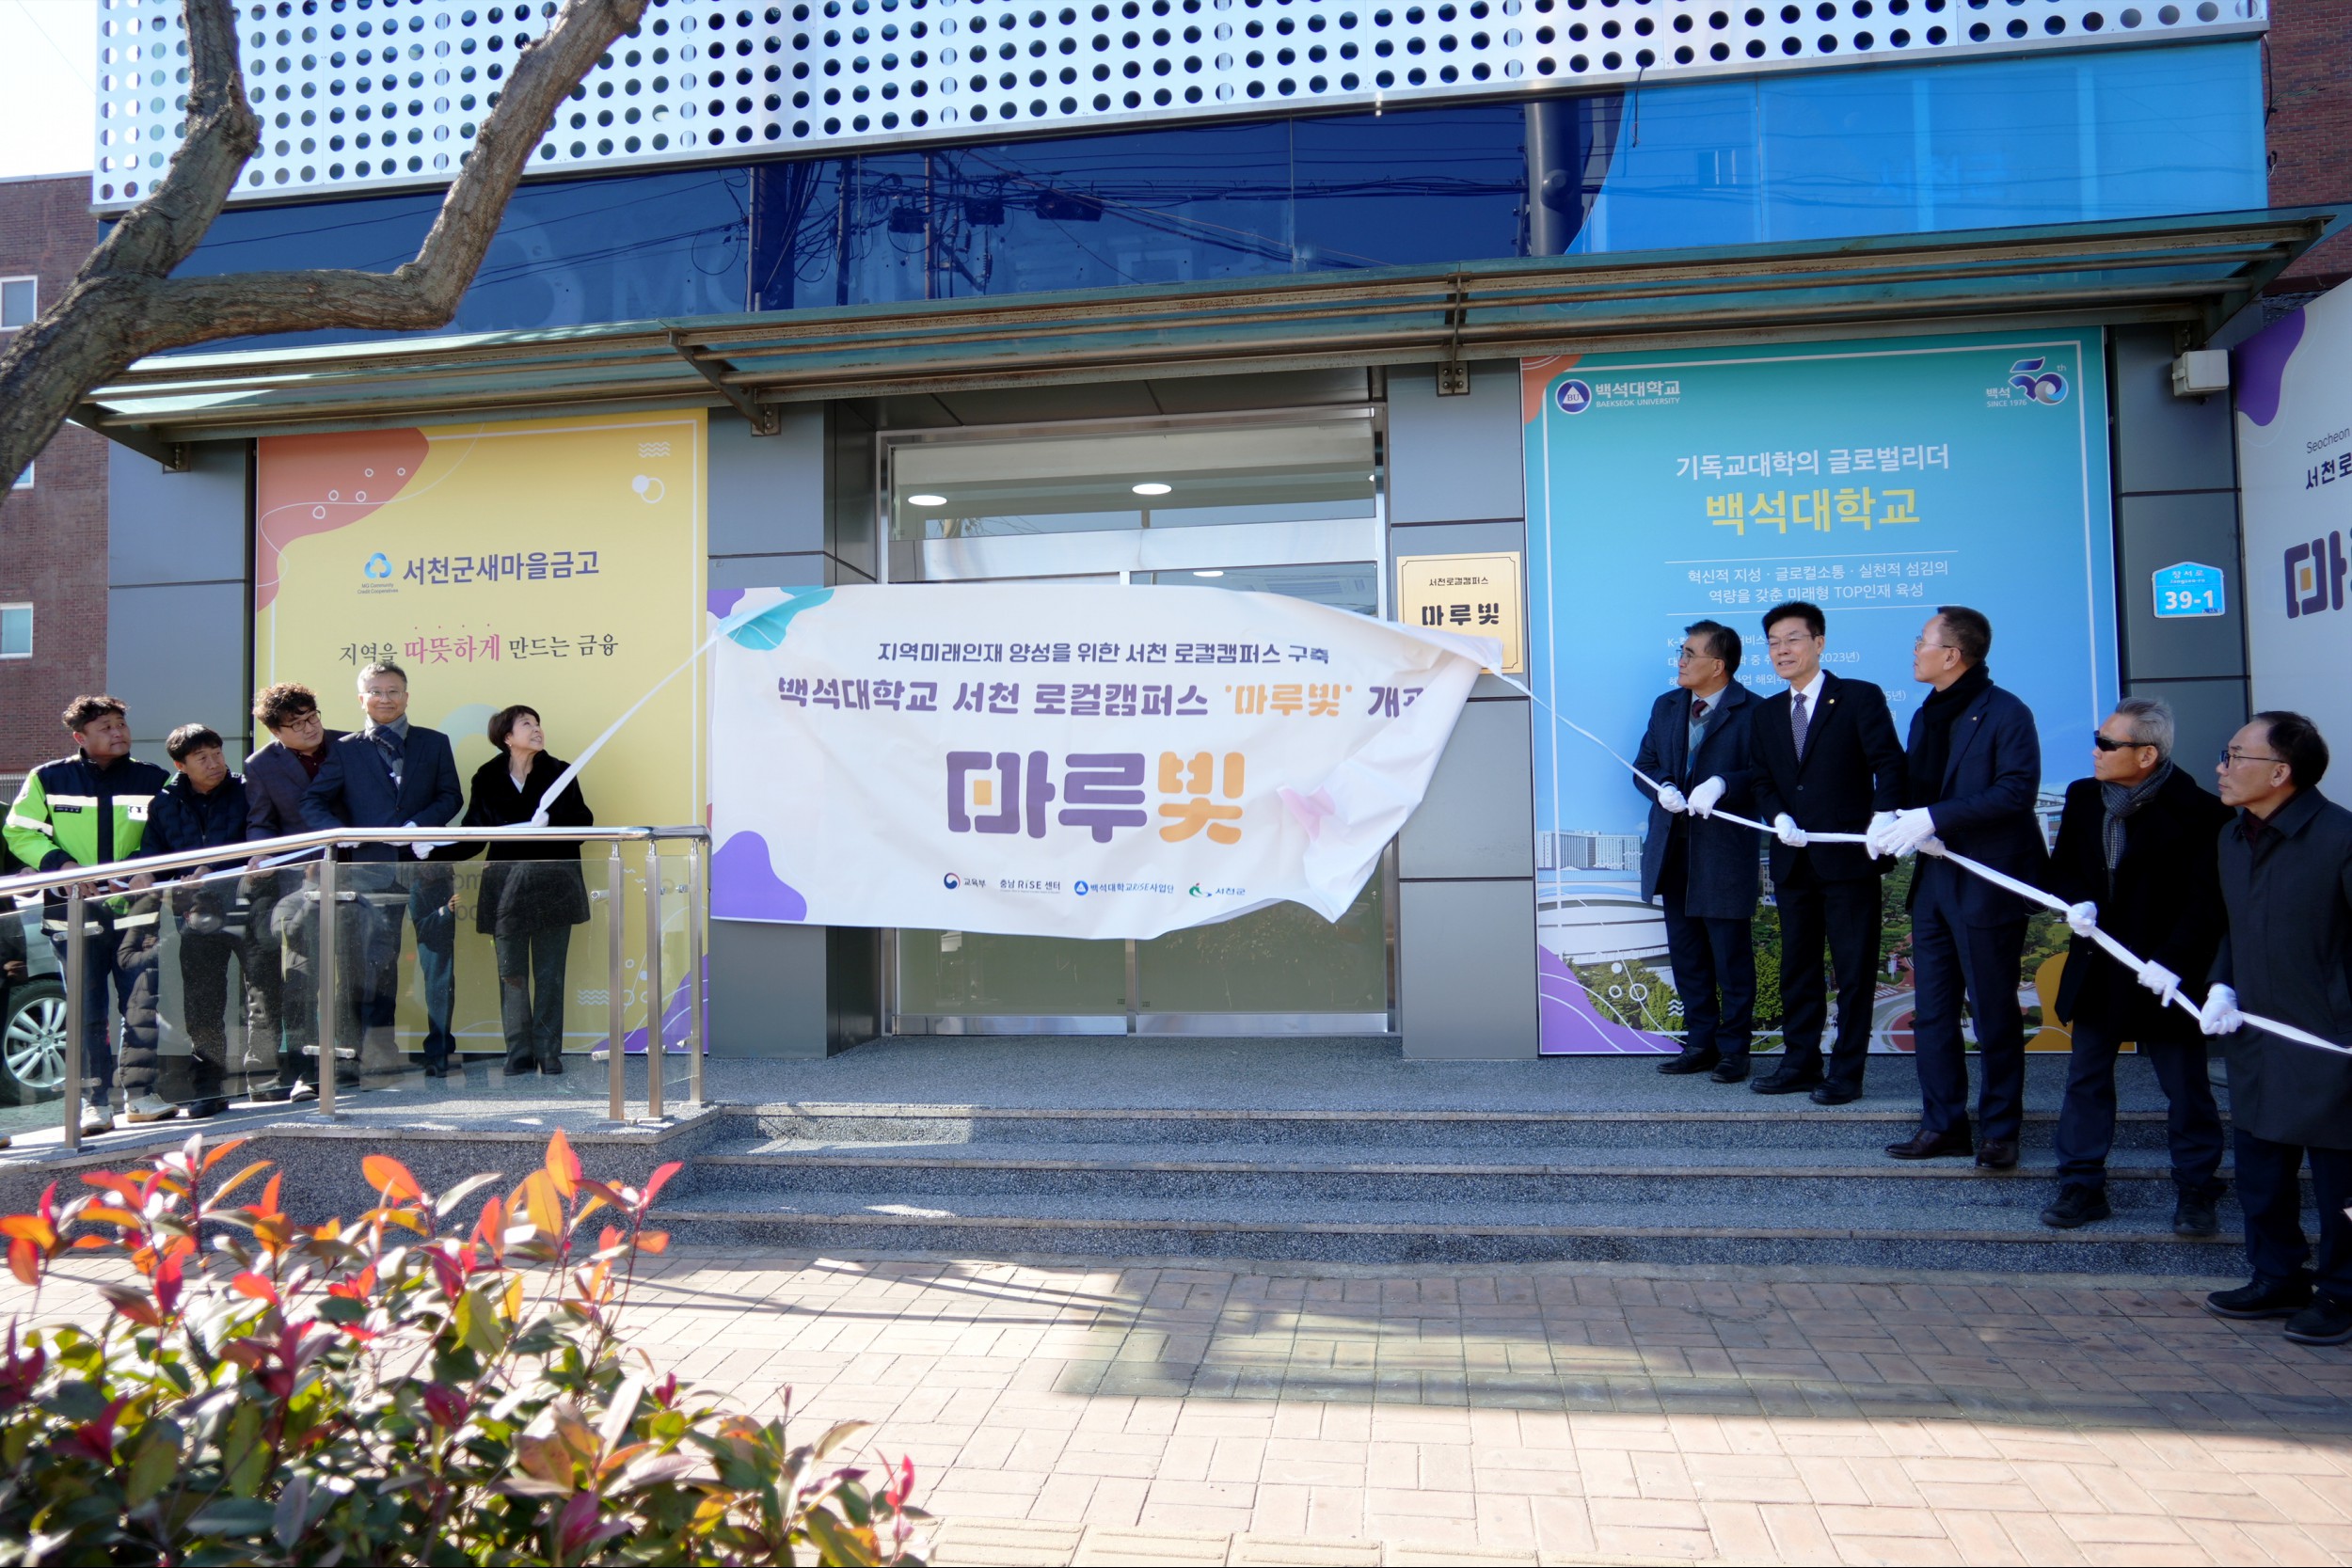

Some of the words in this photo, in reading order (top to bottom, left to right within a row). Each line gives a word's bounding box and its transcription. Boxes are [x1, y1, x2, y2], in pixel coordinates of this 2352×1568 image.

[1596, 380, 1680, 398] 백석대학교
[1986, 388, 2010, 399] 백석
[1597, 399, 1634, 407] BAEKSEOK
[1637, 397, 1680, 405] UNIVERSITY
[2306, 428, 2350, 453] Seocheon
[1677, 450, 1820, 480] 기독교대학의
[1828, 443, 1949, 474] 글로벌리더
[1706, 486, 1920, 536] 백석대학교
[403, 550, 599, 585] 서천군새마을금고
[1688, 568, 1729, 584] 혁신적
[1734, 566, 1762, 582] 지성
[1775, 563, 1845, 581] 글로컬소통
[1859, 562, 1900, 578] 실천적
[1906, 560, 1949, 576] 섬김의
[2284, 530, 2352, 619] 마
[1708, 588, 1751, 605] 역량을
[1756, 586, 1783, 603] 갖춘
[1788, 584, 1829, 602] 미래형
[1835, 582, 1891, 600] TOP인재
[1896, 581, 1924, 598] 육성
[2165, 590, 2214, 610] 39-1
[1422, 602, 1500, 626] 마루빛
[339, 642, 398, 665] 지역을
[404, 633, 501, 664] 따뜻하게
[509, 636, 570, 659] 만드는
[577, 633, 618, 657] 금융
[878, 642, 1003, 662] 지역미래인재
[1009, 642, 1072, 662] 양성을
[1077, 642, 1120, 662] 위한
[1125, 642, 1167, 663] 서천
[1174, 642, 1280, 663] 로컬캠퍼스
[1288, 645, 1329, 664] 구축
[1819, 652, 1860, 662] 2023년)
[778, 676, 938, 711] 백석대학교
[952, 682, 1021, 714] 서천
[1033, 683, 1208, 717] 로컬캠퍼스
[946, 750, 1245, 844] 마루빛
[963, 878, 987, 888] 교육부
[1000, 879, 1015, 889] 충남
[1045, 880, 1060, 891] 센터
